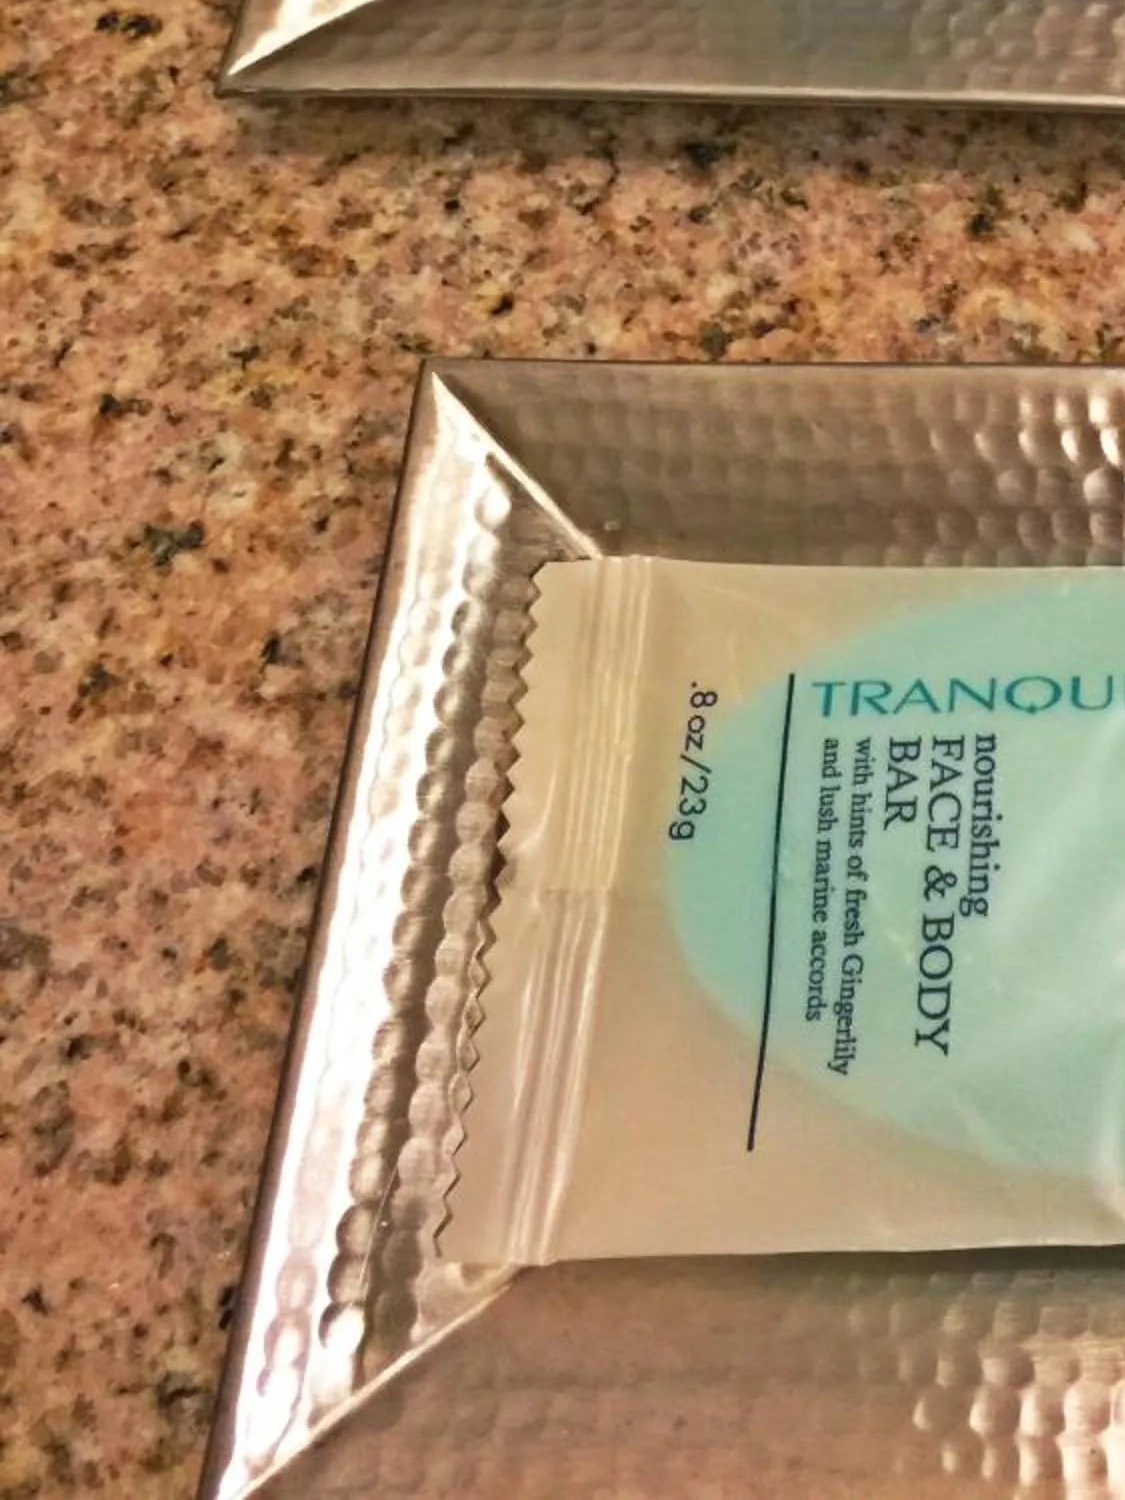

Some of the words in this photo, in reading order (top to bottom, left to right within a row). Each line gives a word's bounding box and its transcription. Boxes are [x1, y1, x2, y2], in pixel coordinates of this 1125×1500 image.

[821, 737, 843, 779] and
[852, 736, 877, 787] with
[882, 735, 923, 832] BAR
[925, 733, 966, 853] FACE
[817, 785, 842, 834] lush
[848, 792, 873, 849] hints
[958, 732, 1001, 918] nourishing
[812, 838, 836, 924] marine
[846, 854, 869, 882] of
[922, 863, 959, 902] &
[843, 888, 869, 948] fresh
[804, 929, 829, 1023] accords
[913, 912, 956, 1058] BODY
[826, 953, 865, 1077] Gingerlily
